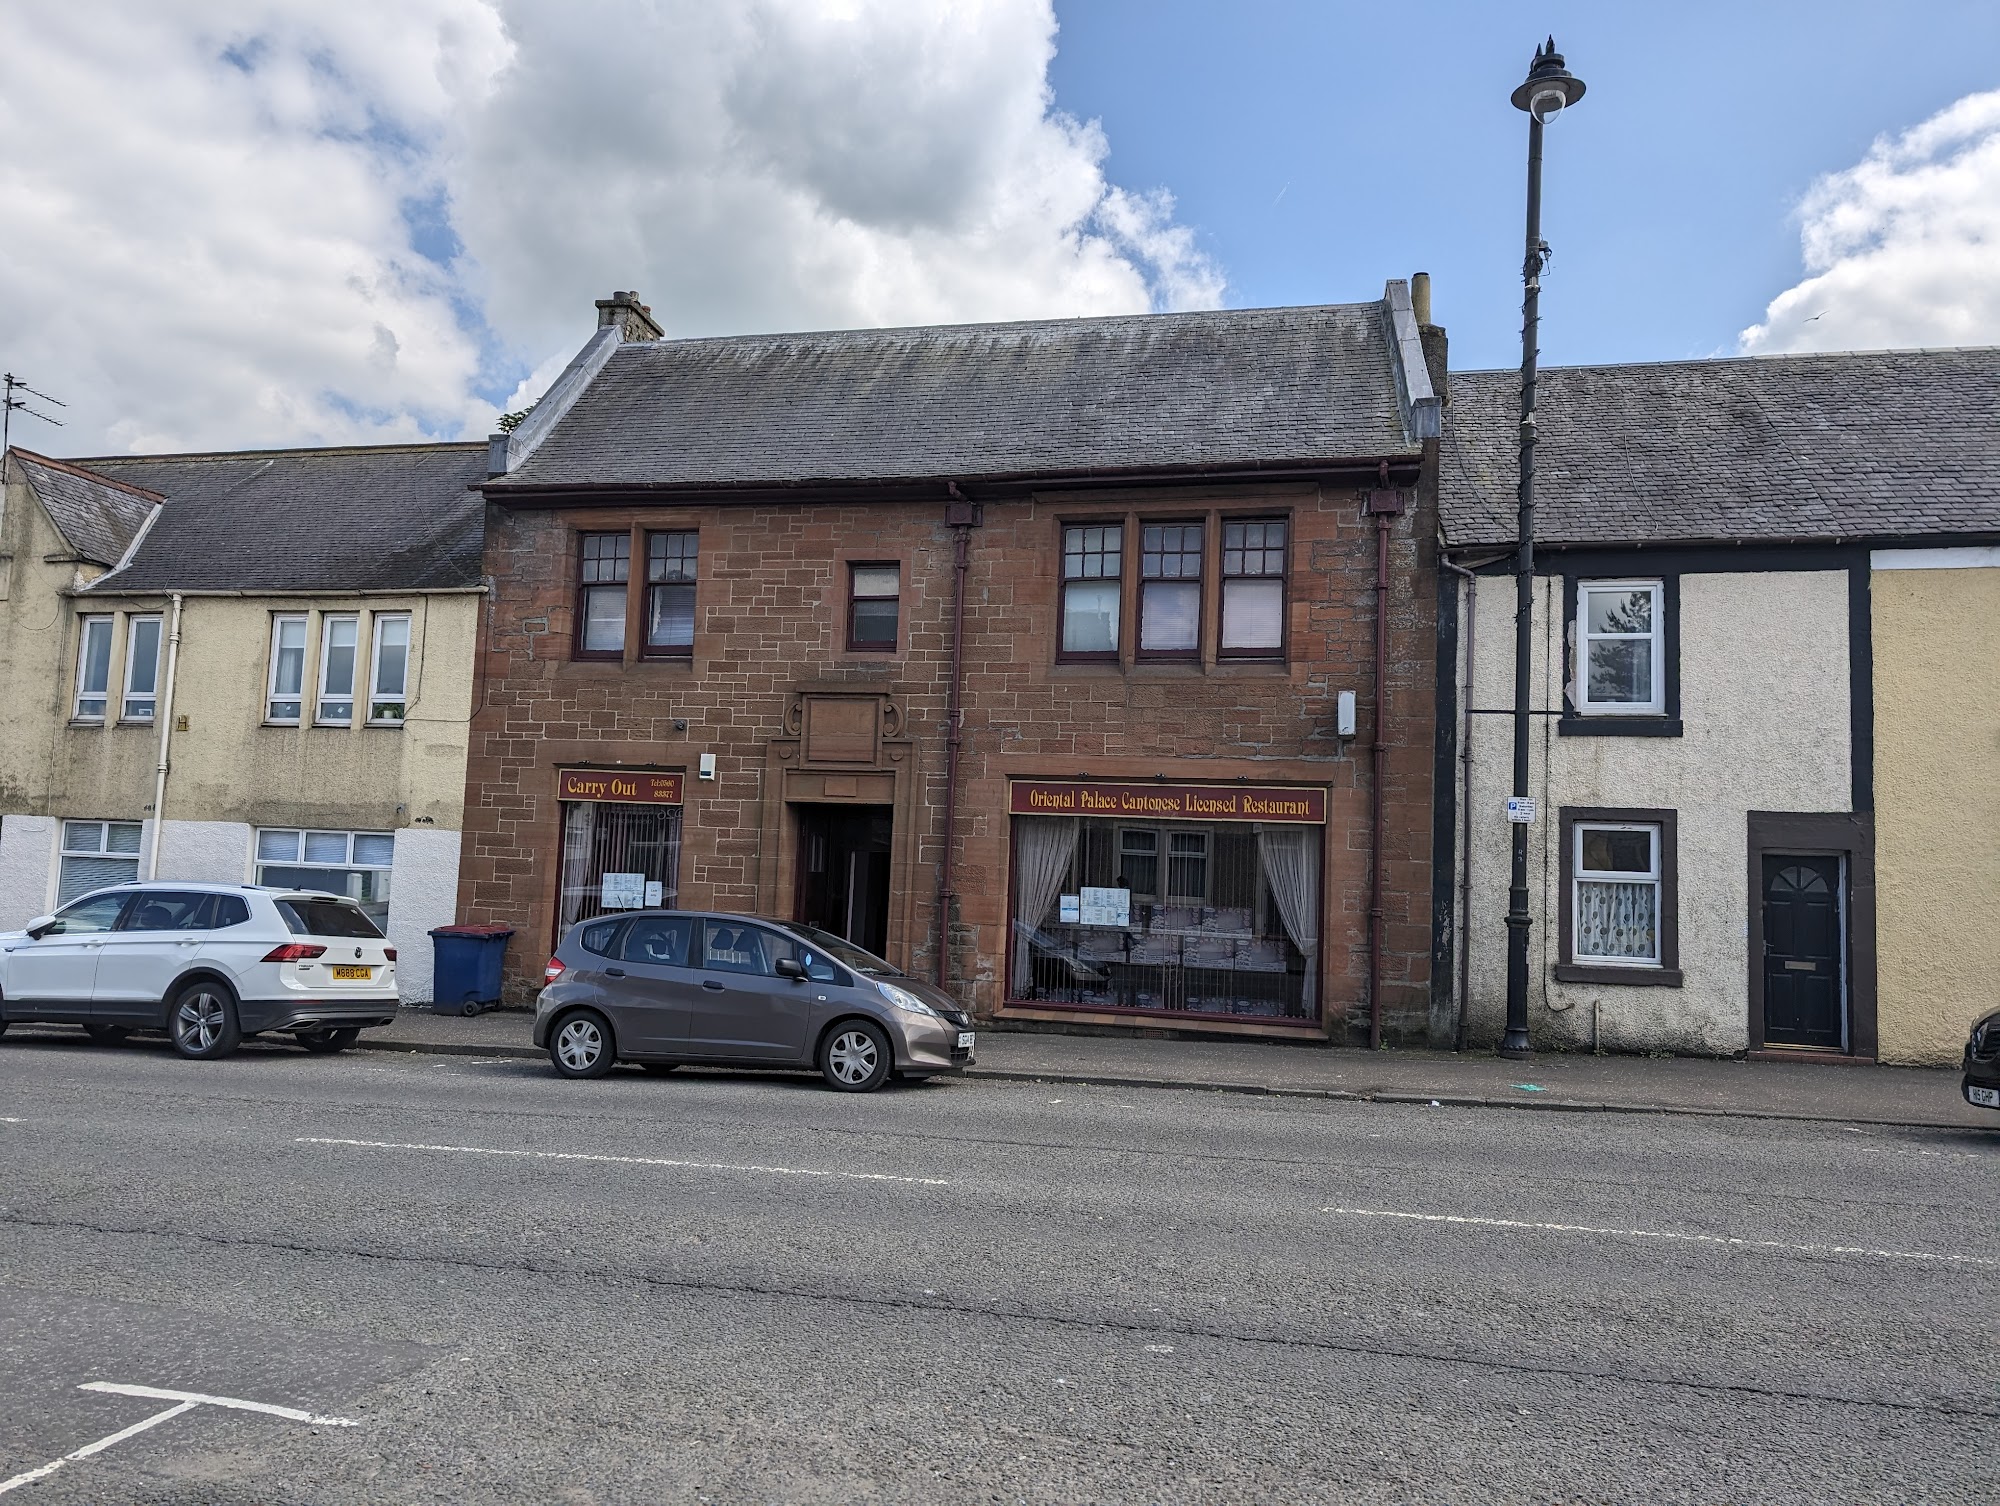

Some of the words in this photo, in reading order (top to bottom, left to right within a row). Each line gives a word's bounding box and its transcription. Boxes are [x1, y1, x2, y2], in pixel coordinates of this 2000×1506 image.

[567, 776, 608, 798] Carry
[611, 778, 637, 796] Out
[653, 790, 674, 798] 83377
[1030, 789, 1075, 810] Oriental
[1081, 790, 1117, 809] Palace
[1121, 791, 1180, 813] Cantonese
[1185, 793, 1236, 815] Licensed
[1242, 795, 1310, 818] Restaurant
